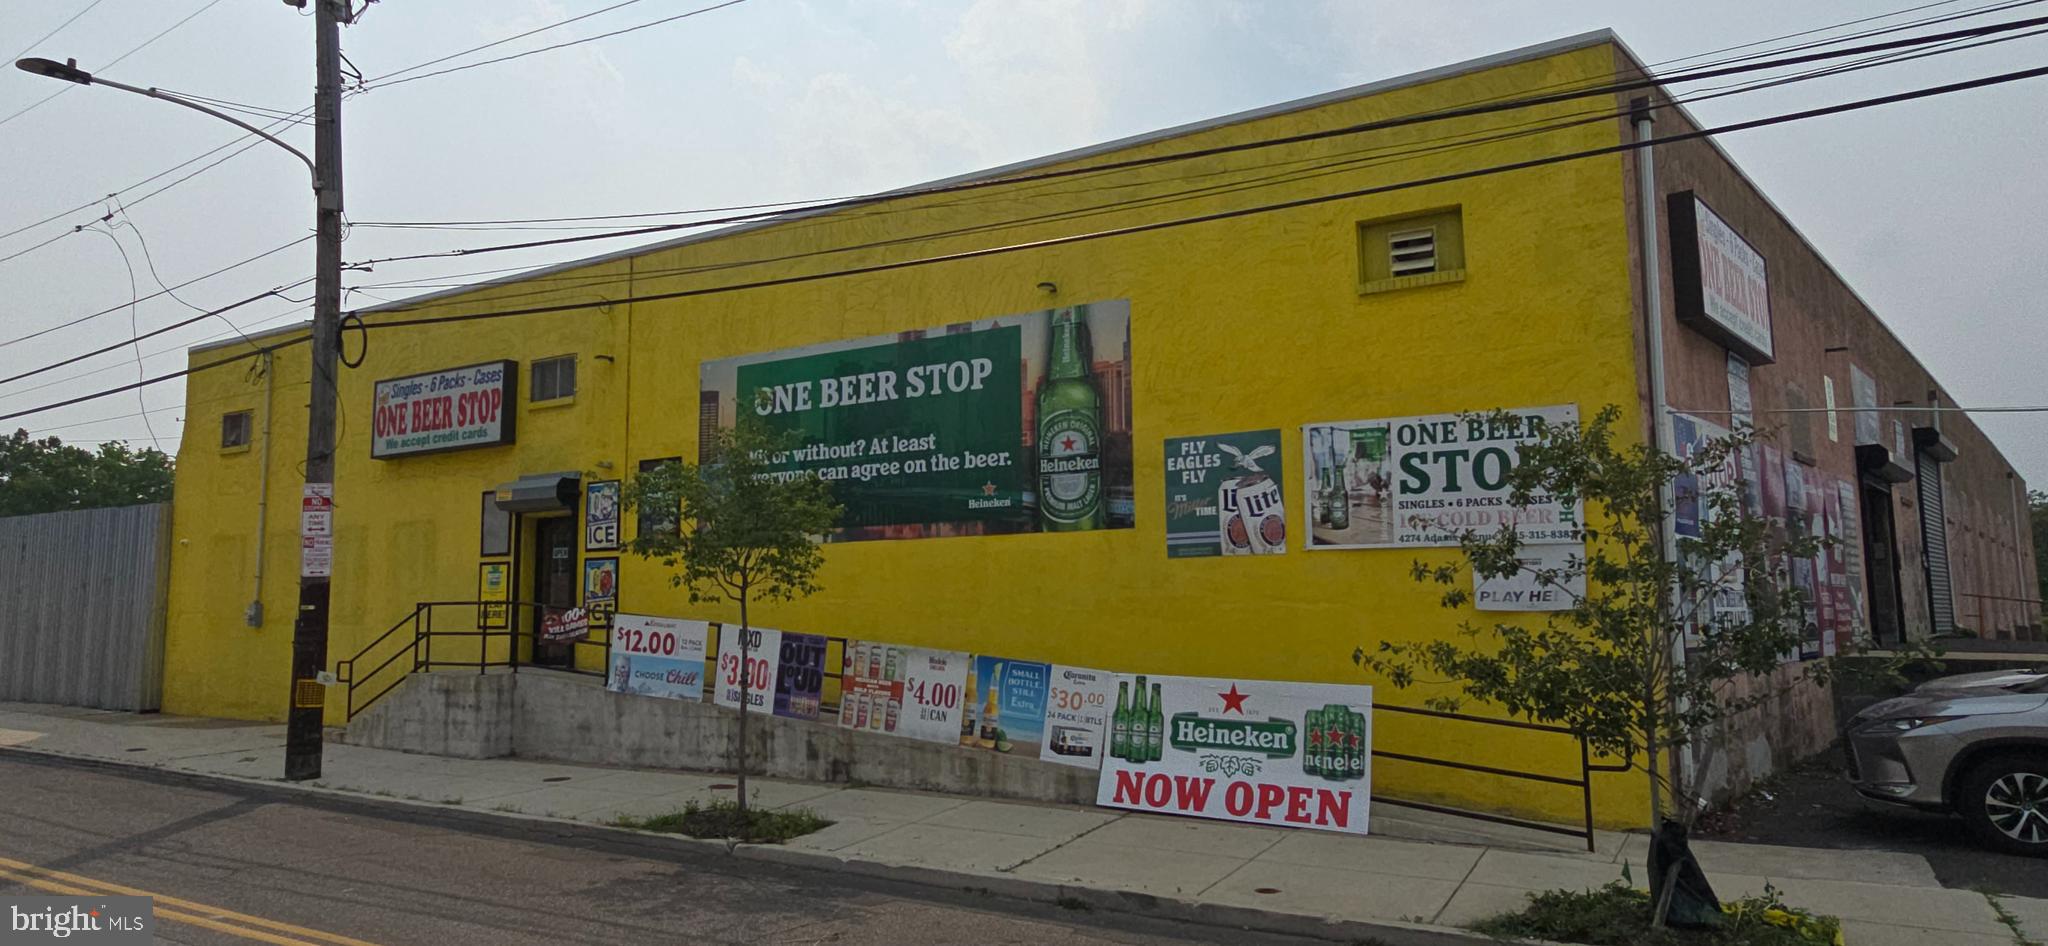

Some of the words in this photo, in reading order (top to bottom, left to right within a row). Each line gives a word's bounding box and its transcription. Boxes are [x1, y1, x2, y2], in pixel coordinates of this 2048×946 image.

[391, 380, 422, 399] Singles
[430, 376, 438, 392] 6
[438, 374, 466, 391] Packs
[474, 368, 502, 384] Cases
[755, 381, 812, 416] ONE
[820, 370, 898, 408] BEER
[906, 358, 992, 398] STOP
[376, 402, 408, 438] ONE
[412, 395, 452, 433] BEER
[457, 388, 502, 428] STOP
[386, 438, 399, 450] We
[400, 434, 430, 448] accept
[433, 431, 459, 444] credit
[462, 426, 488, 440] cards
[1397, 420, 1457, 446] ONE
[772, 450, 790, 464] or
[792, 439, 866, 464] without?
[870, 438, 890, 456] At
[892, 432, 936, 452] least
[1181, 440, 1206, 455] FLY
[818, 466, 848, 481] can
[851, 463, 900, 481] agree
[904, 458, 926, 474] on
[931, 453, 960, 471] the
[964, 450, 1012, 469] beer.
[1040, 456, 1100, 474] Heineken
[1168, 454, 1221, 471] EAGLES
[1400, 446, 1546, 495] STO
[1182, 470, 1206, 484] FLY
[968, 496, 1011, 510] Heineken
[1222, 488, 1237, 512] Li
[1244, 488, 1279, 518] Lite
[1398, 500, 1445, 510] SINGLES
[1456, 498, 1463, 507] 6
[1466, 497, 1502, 507] PACKS
[1196, 506, 1218, 516] TIME
[1437, 510, 1491, 526] COLD
[1498, 508, 1554, 525] BEER
[589, 526, 614, 544] ICE
[1398, 535, 1421, 543] 4274
[1480, 590, 1524, 602] PLAY
[618, 626, 675, 655] $12.00
[781, 642, 820, 667] OUT
[635, 670, 664, 681] CHOOSE
[666, 669, 698, 686] Chill
[1012, 669, 1039, 680] SMALL
[1063, 670, 1096, 682] Coronita
[734, 690, 764, 706] SIGLES
[907, 677, 956, 709] $4.00
[1012, 688, 1035, 697] STILL
[1051, 687, 1104, 710] $30.00
[930, 710, 947, 722] CAN
[1057, 713, 1076, 722] PACK
[1177, 720, 1288, 749] Heineken
[1113, 770, 1216, 812] NOW
[1225, 780, 1352, 828] OPEN
